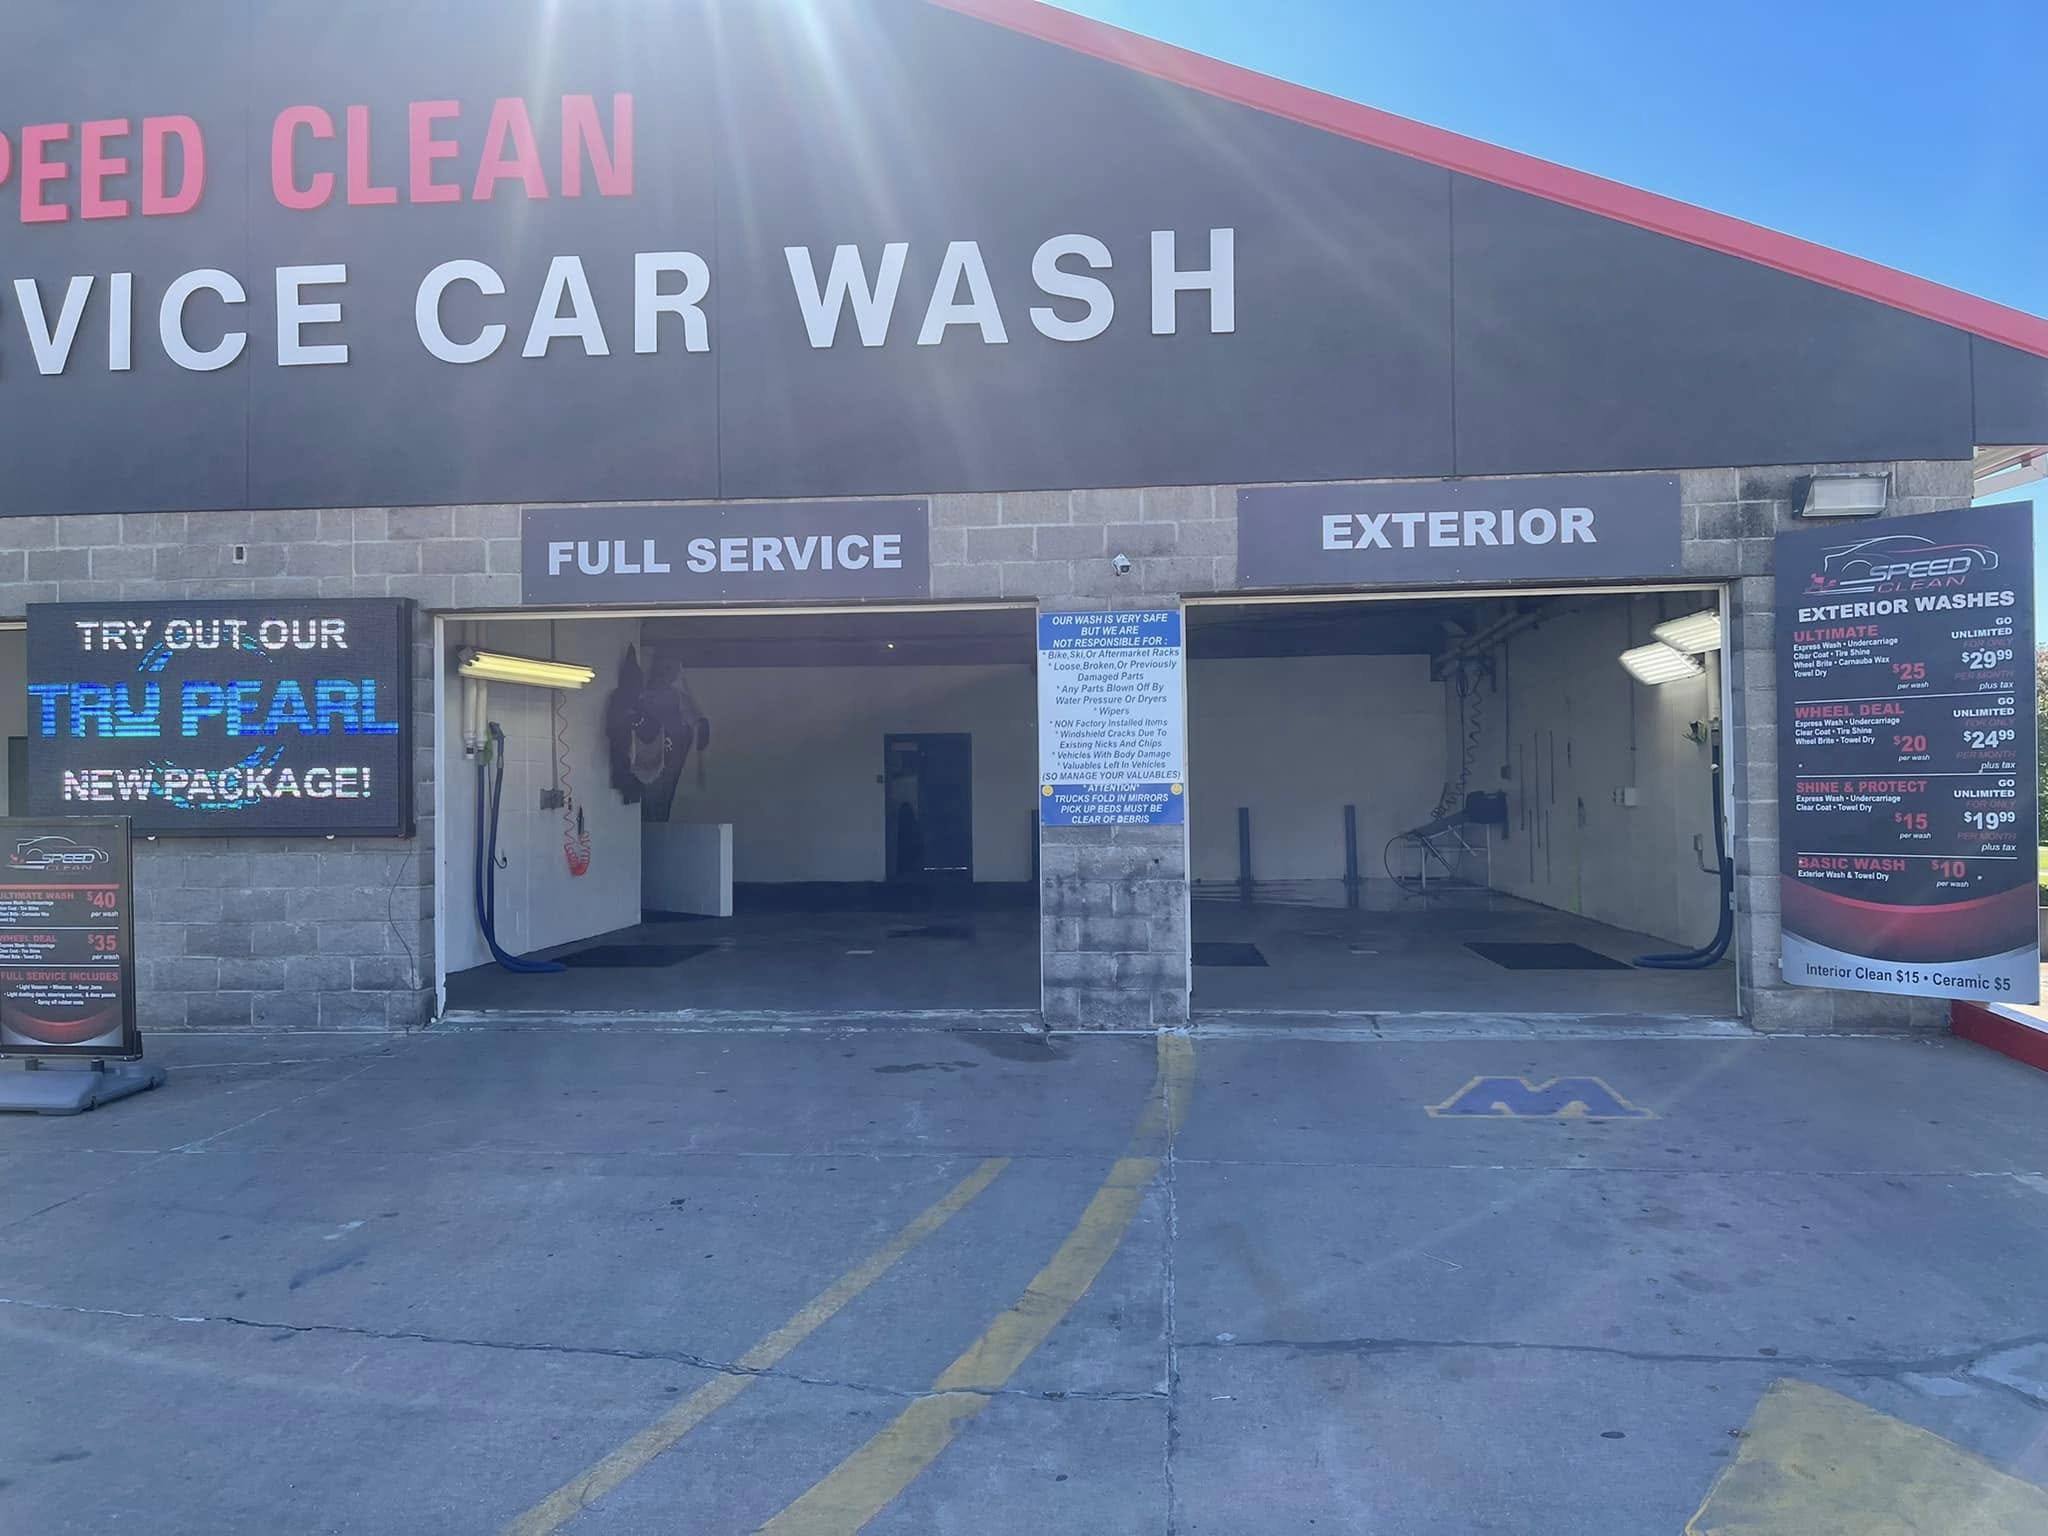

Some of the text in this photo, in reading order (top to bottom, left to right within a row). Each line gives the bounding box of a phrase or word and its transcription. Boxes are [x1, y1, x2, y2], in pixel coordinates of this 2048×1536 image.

[0, 93, 634, 223] EED CLEAN
[415, 250, 711, 363] CAR
[783, 227, 1236, 349] WASH
[1322, 507, 1597, 550] EXTERIOR
[548, 534, 902, 576] FULL SERVICE
[1869, 556, 1972, 581] SPEED
[1877, 575, 1968, 593] CLEAN
[1798, 590, 2015, 623] EXTERIOR WASHES
[1052, 613, 1168, 625] OUR WASH IS VERY SAFE
[1995, 617, 2012, 625] GO
[75, 618, 348, 650] TRY OUT OUR
[1081, 626, 1139, 636] BUT WE ARE
[1793, 624, 1879, 642] ULTIMATE
[1951, 627, 2013, 639] UNLIMITED
[1053, 637, 1162, 648] NOT RESPONSIBLE FOR
[1098, 649, 1151, 658] Aftermarket
[1152, 648, 1180, 656] Racks
[1130, 660, 1177, 670] Previously
[1892, 662, 1925, 680] $25
[1078, 672, 1144, 683] Damaged Parts
[1061, 683, 1164, 694] Any Parts Blown Off By
[1979, 681, 2014, 690] plus tax
[1056, 695, 1167, 705] Water Pressure Or Dryers
[1998, 697, 2014, 705] GO
[28, 679, 399, 737] TRU PEARL
[1099, 707, 1130, 716] Wipers
[1795, 703, 1904, 718] WHEEL DEAL
[1953, 708, 2015, 717] UNLIMITED
[1055, 720, 1074, 728] NON
[1075, 720, 1106, 729] Factory
[1795, 720, 1823, 728] Express
[1849, 717, 1900, 726] Undercarriage
[1060, 730, 1105, 738] Windshield
[1107, 729, 1136, 737] Cracks
[1059, 741, 1092, 749] Existing
[1139, 740, 1162, 748] Chips
[1894, 735, 1927, 752] $20
[1057, 751, 1091, 759] Vehicles
[1114, 750, 1135, 759] Body
[1137, 750, 1171, 758] Damage
[1062, 760, 1166, 770] Valuables Left In Vehicles
[1981, 761, 1999, 770] plus
[1042, 771, 1181, 781] (SO MANAGE YOUR VALUABLES)
[63, 767, 371, 800] NEW PACKAGE!
[1796, 780, 1928, 793] SHINE & PROTECT
[1998, 779, 2015, 787] GO
[1055, 794, 1168, 803] TRUCKS FOLD IN MIRRORS
[1796, 795, 1823, 803] Express
[1850, 795, 1901, 803] Undercarriage
[1954, 790, 2015, 798] UNLIMITED
[1098, 805, 1121, 813] BEDS
[1123, 805, 1147, 813] MUST
[1150, 804, 1163, 812] BE
[1860, 804, 1872, 813] Dry
[1072, 815, 1150, 824] CLEAR OF DEBRIS
[1895, 812, 1928, 830] $15
[1981, 843, 2000, 852] plus
[42, 854, 95, 863] SPEED
[1798, 857, 1906, 872] BASIC WASH
[1931, 860, 1966, 878] $10
[1798, 870, 1889, 882] Exterior Wash & Towel Dry
[87, 891, 115, 908] $40
[88, 934, 116, 951] $35
[0, 972, 118, 980] FULL SERVICE INCLUDES
[1806, 963, 2011, 991] Interior Clean $15 Ceramic $5
